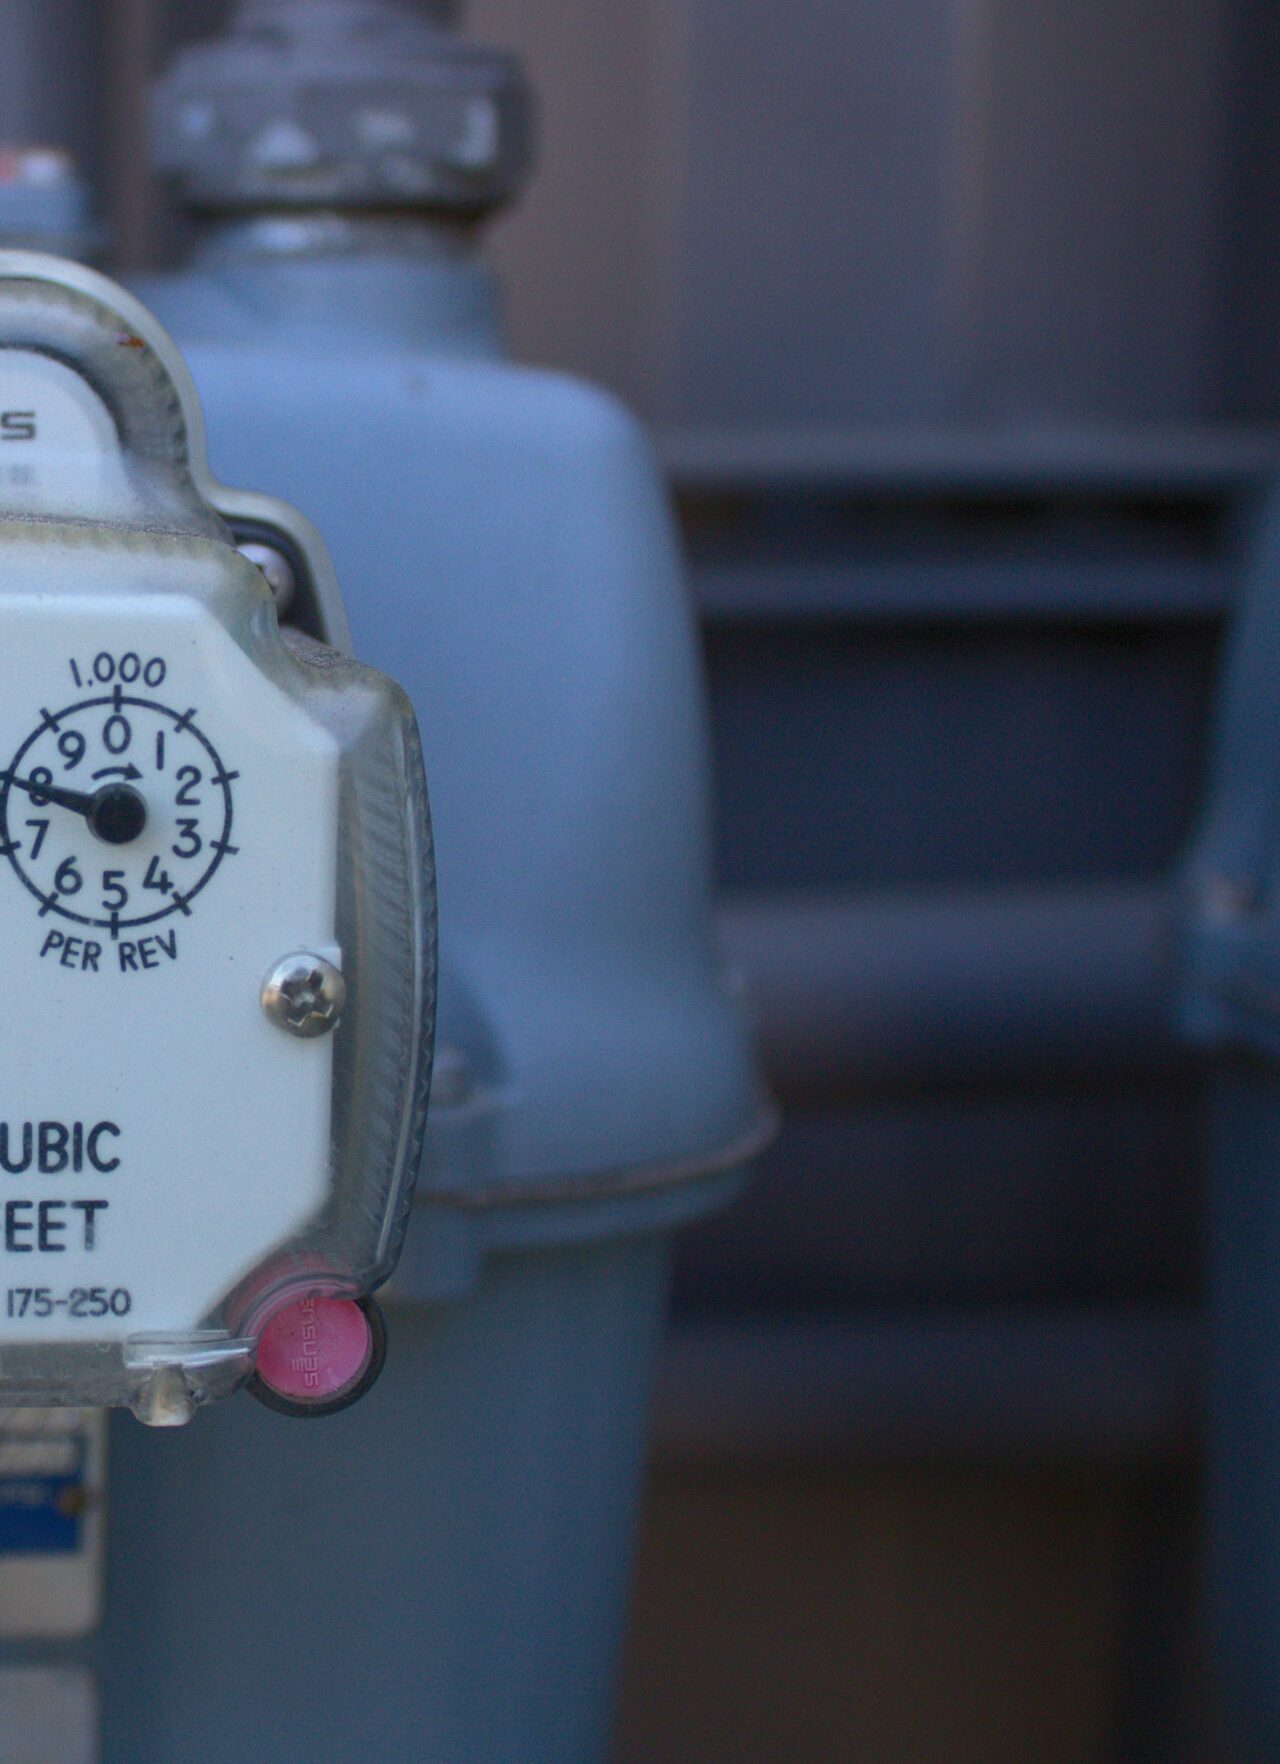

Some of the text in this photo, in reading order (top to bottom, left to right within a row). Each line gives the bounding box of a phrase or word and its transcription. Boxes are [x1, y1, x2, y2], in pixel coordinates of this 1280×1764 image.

[70, 652, 166, 687] 1,000
[58, 730, 86, 770] 9
[103, 715, 131, 755] 0
[156, 731, 164, 770] 1
[175, 766, 201, 805] 2
[26, 819, 49, 859] 7
[172, 819, 202, 858] 3
[54, 855, 82, 895] 6
[102, 871, 128, 911] 5
[142, 855, 174, 895] 4
[40, 929, 177, 972] PER REV
[7, 1287, 132, 1318] 175-250
